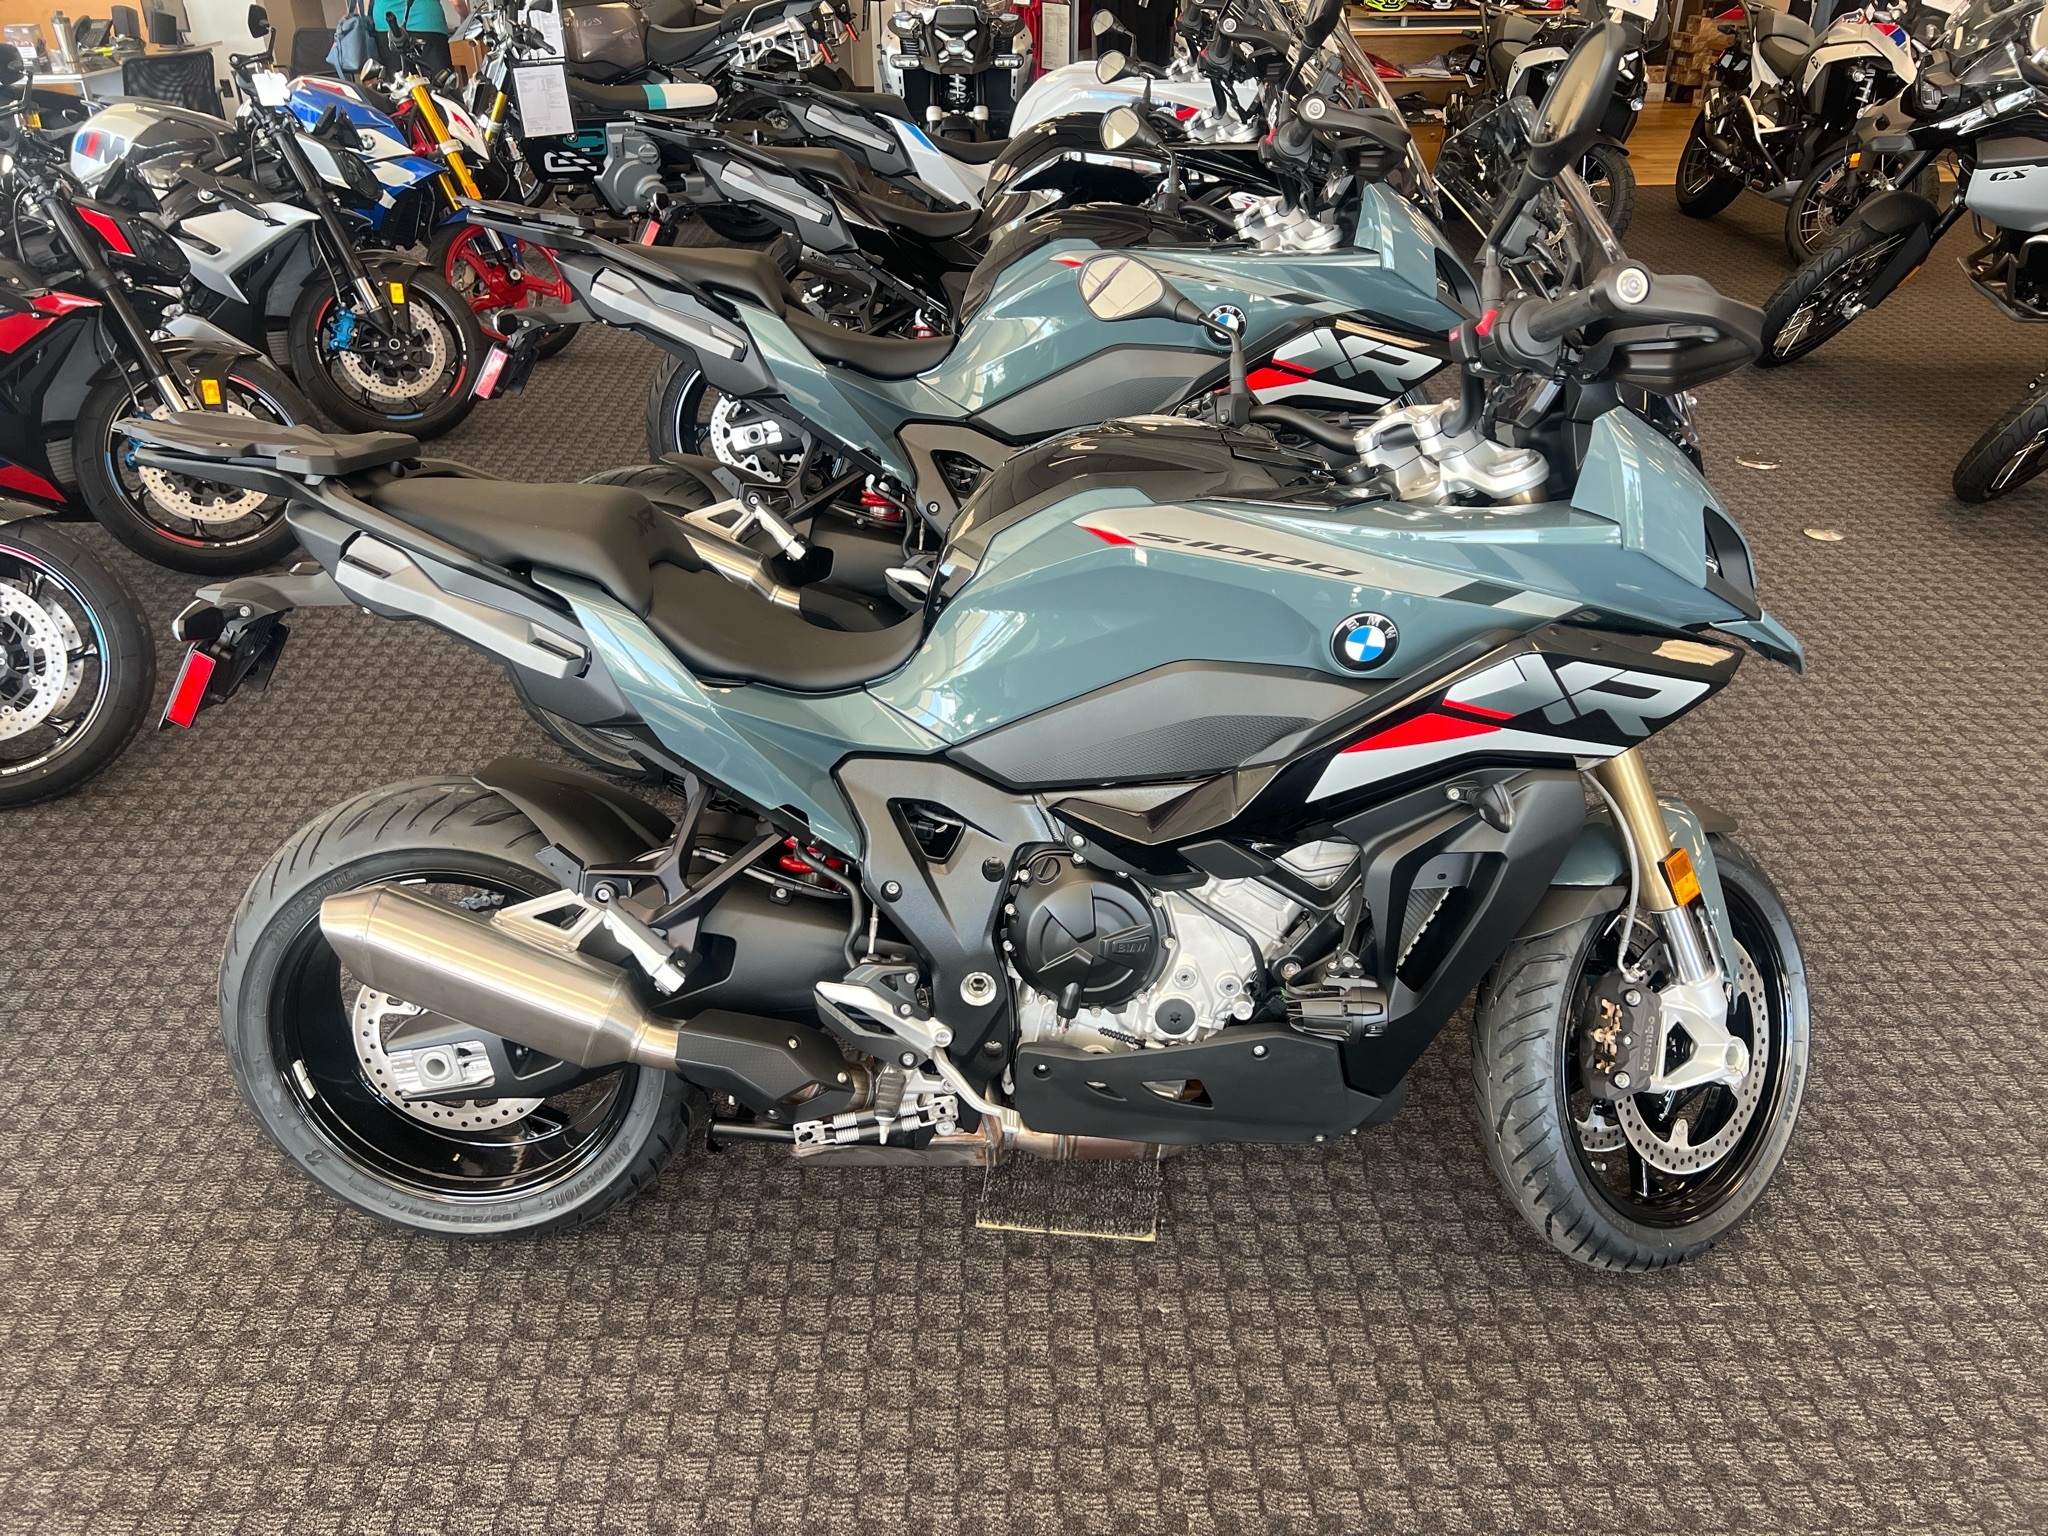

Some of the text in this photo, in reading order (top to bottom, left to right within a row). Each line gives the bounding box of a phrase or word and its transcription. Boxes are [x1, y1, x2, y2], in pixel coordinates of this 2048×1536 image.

[1989, 168, 2030, 182] GS
[1271, 327, 1443, 393] XR
[1128, 531, 1364, 577] S1000
[1345, 615, 1397, 639] BMW
[1443, 654, 1710, 736] XR
[267, 868, 355, 945] BRIDGESTONE
[1117, 942, 1147, 953] BMW
[1640, 1015, 1656, 1072] brembo
[547, 1141, 631, 1212] BRIDGESTONE
